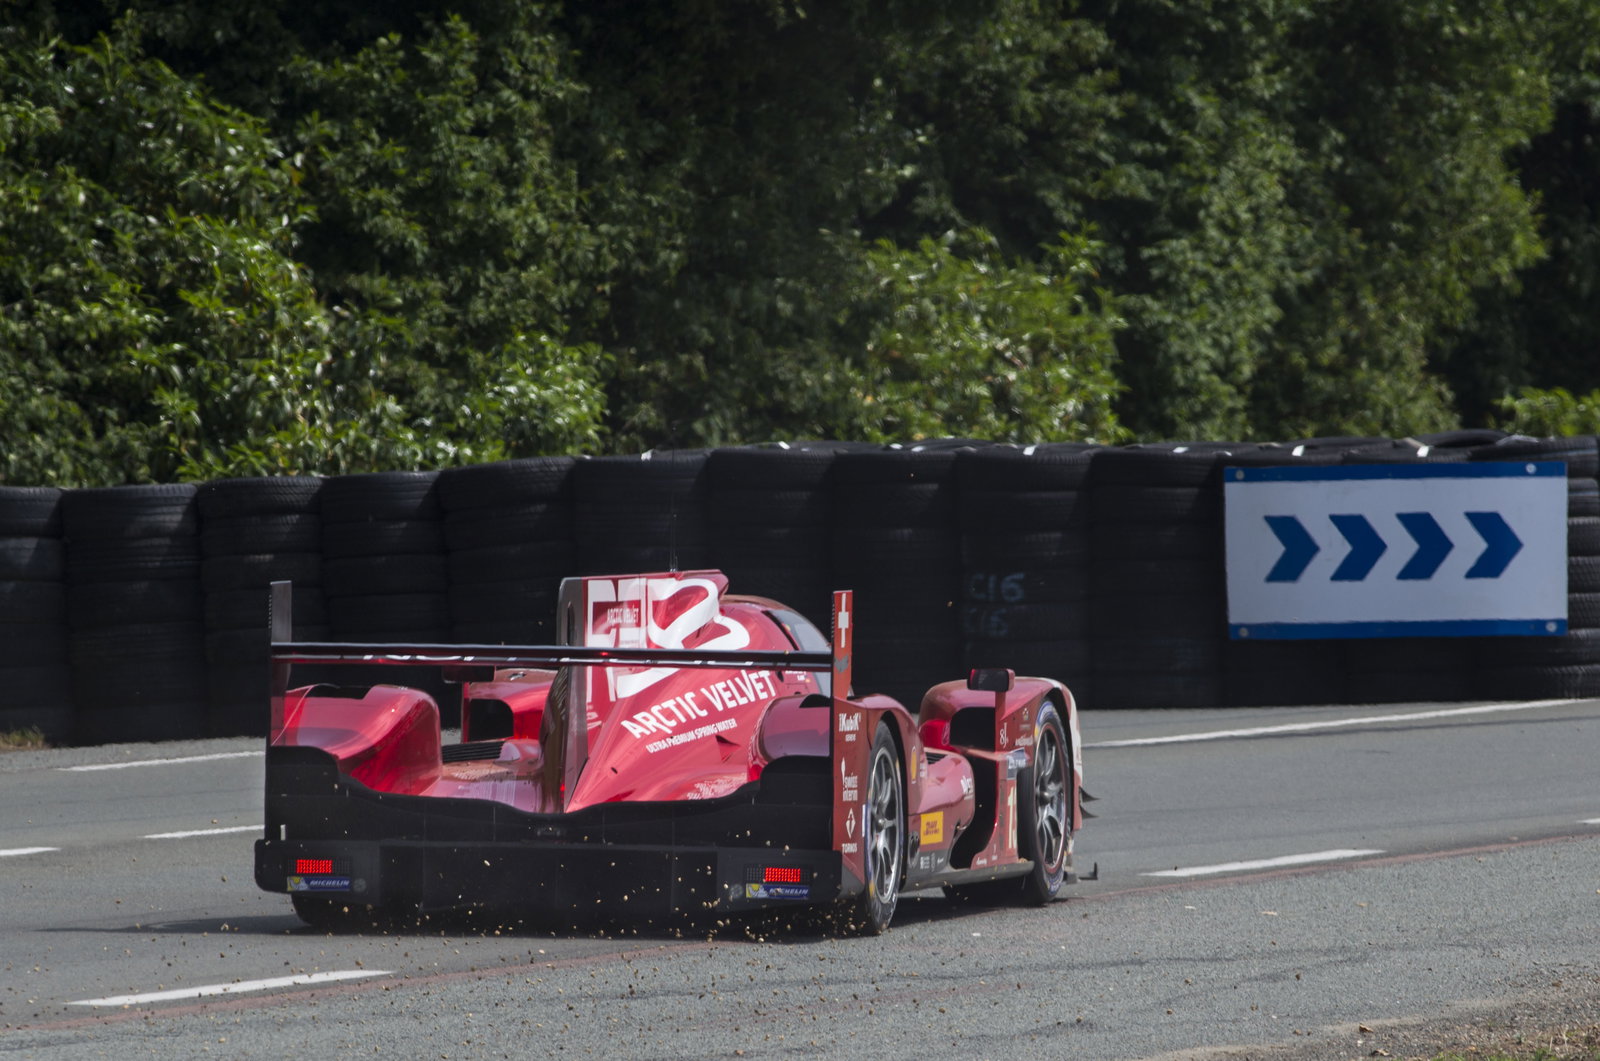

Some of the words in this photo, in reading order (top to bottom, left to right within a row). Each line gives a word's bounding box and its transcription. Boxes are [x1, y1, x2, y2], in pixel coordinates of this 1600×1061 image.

[607, 607, 623, 625] ARCTIC
[620, 691, 709, 739] ARCTIC
[700, 669, 776, 712] VELVET
[645, 739, 670, 754] ULTRA
[666, 730, 696, 747] PREMIUM
[694, 723, 718, 740] SPRING
[716, 718, 738, 732] WATER
[309, 879, 351, 887] MICHELIN
